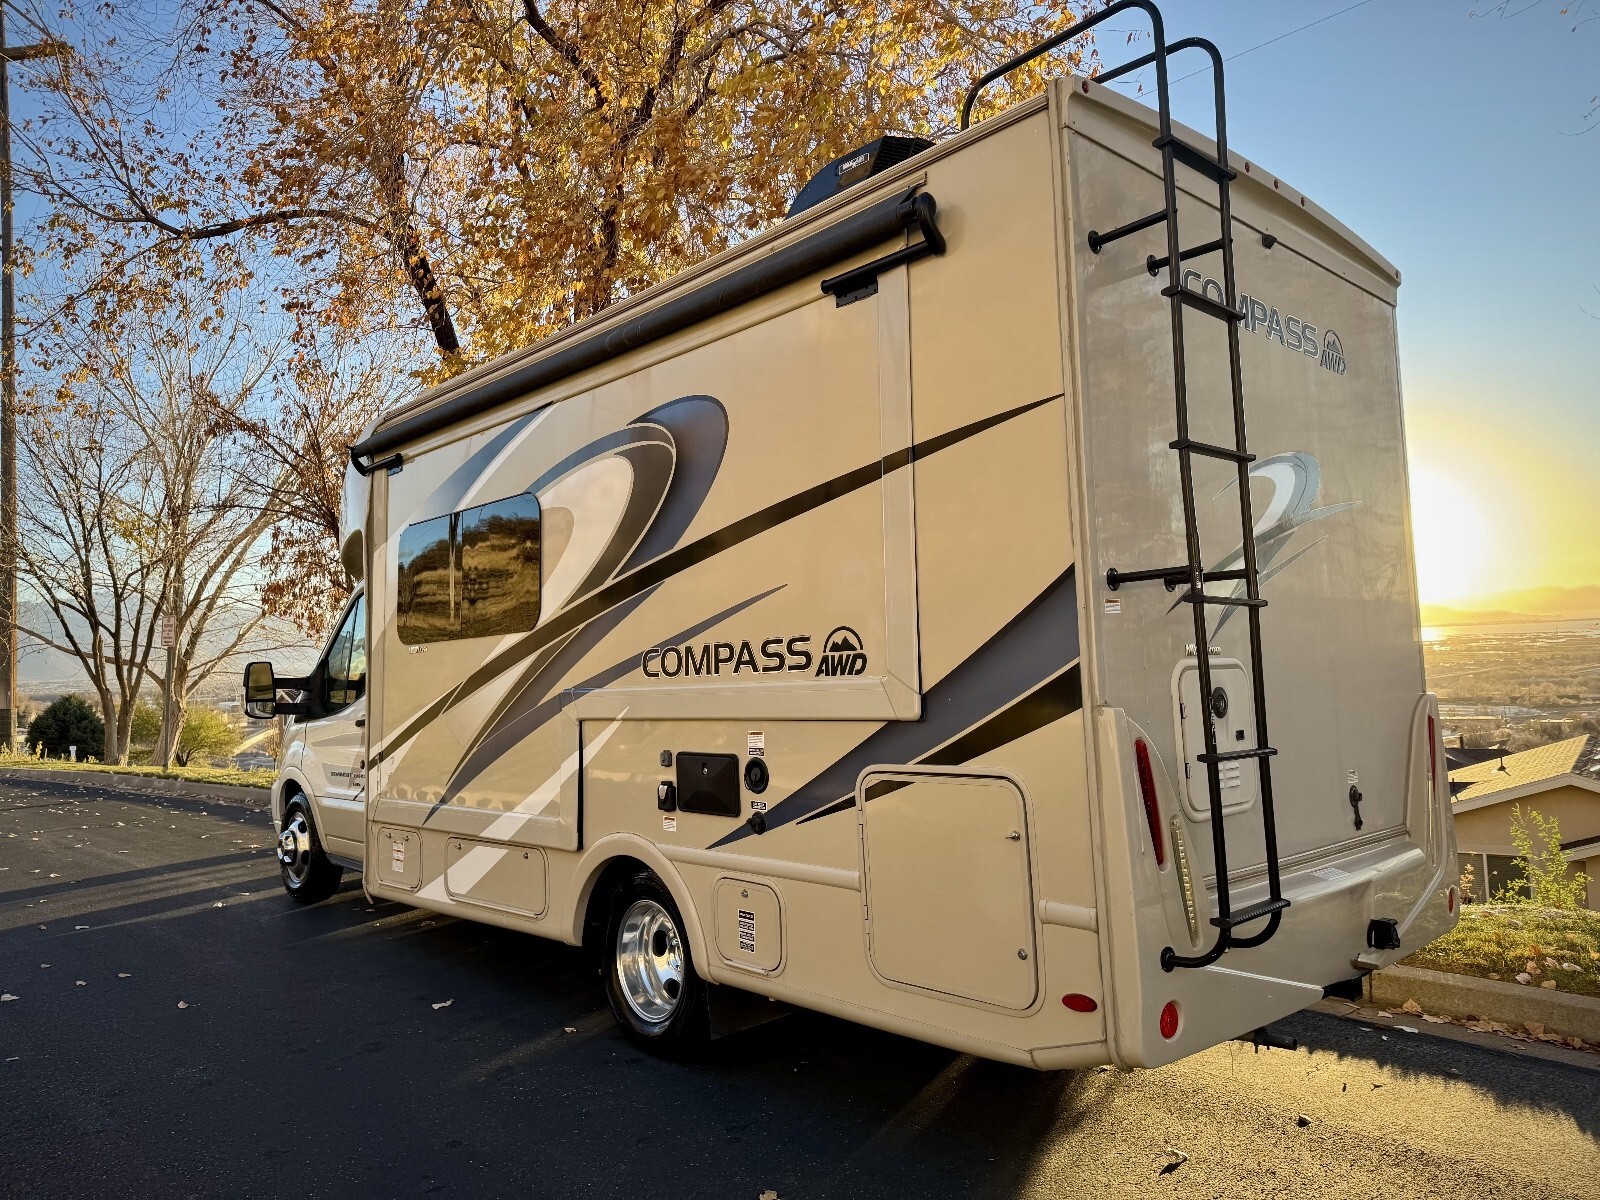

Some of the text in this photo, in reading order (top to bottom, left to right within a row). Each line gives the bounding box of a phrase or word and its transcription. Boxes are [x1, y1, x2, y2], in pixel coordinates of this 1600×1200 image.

[1319, 348, 1347, 376] AWD
[641, 634, 868, 680] COMPASS AWD
